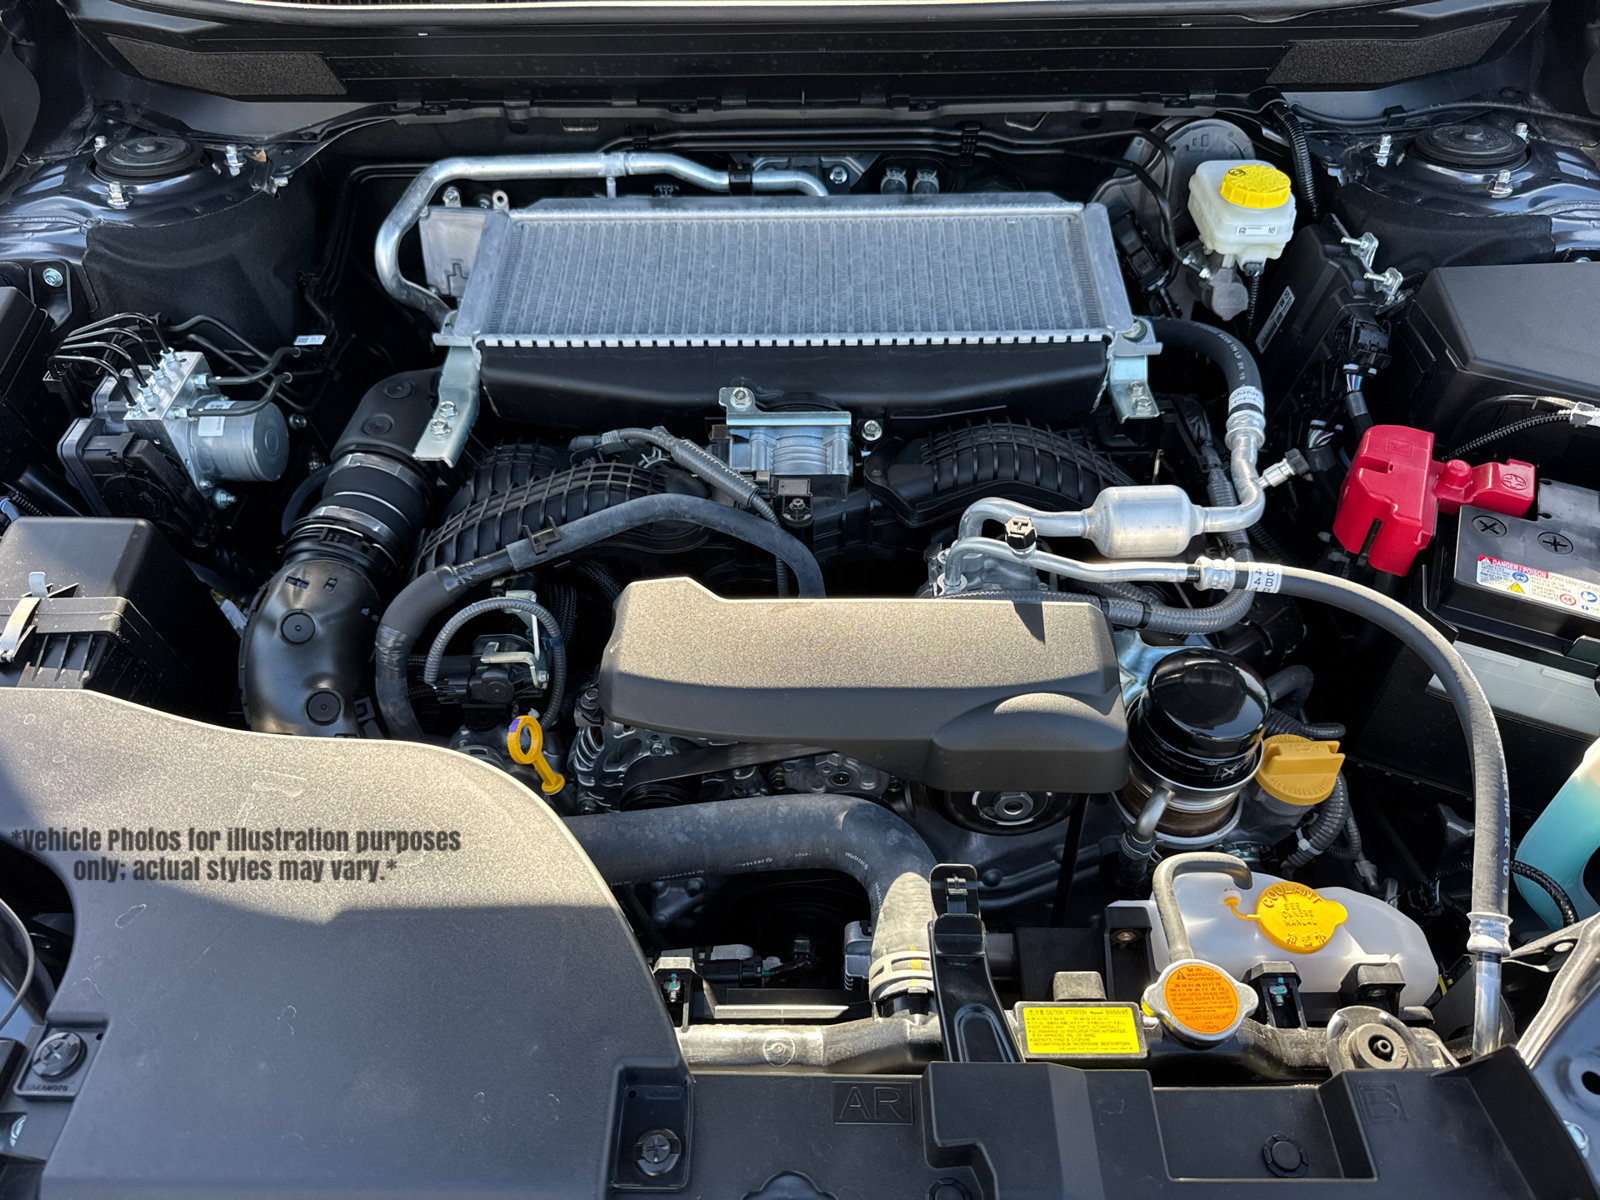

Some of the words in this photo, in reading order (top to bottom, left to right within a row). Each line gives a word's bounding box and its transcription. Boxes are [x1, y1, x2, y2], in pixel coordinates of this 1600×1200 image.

[1492, 559, 1519, 571] DANGER
[1523, 567, 1546, 579] POISON
[1253, 577, 1261, 586] 4
[1265, 578, 1274, 587] B
[1262, 884, 1323, 909] COOLANT
[839, 1086, 904, 1120] AR
